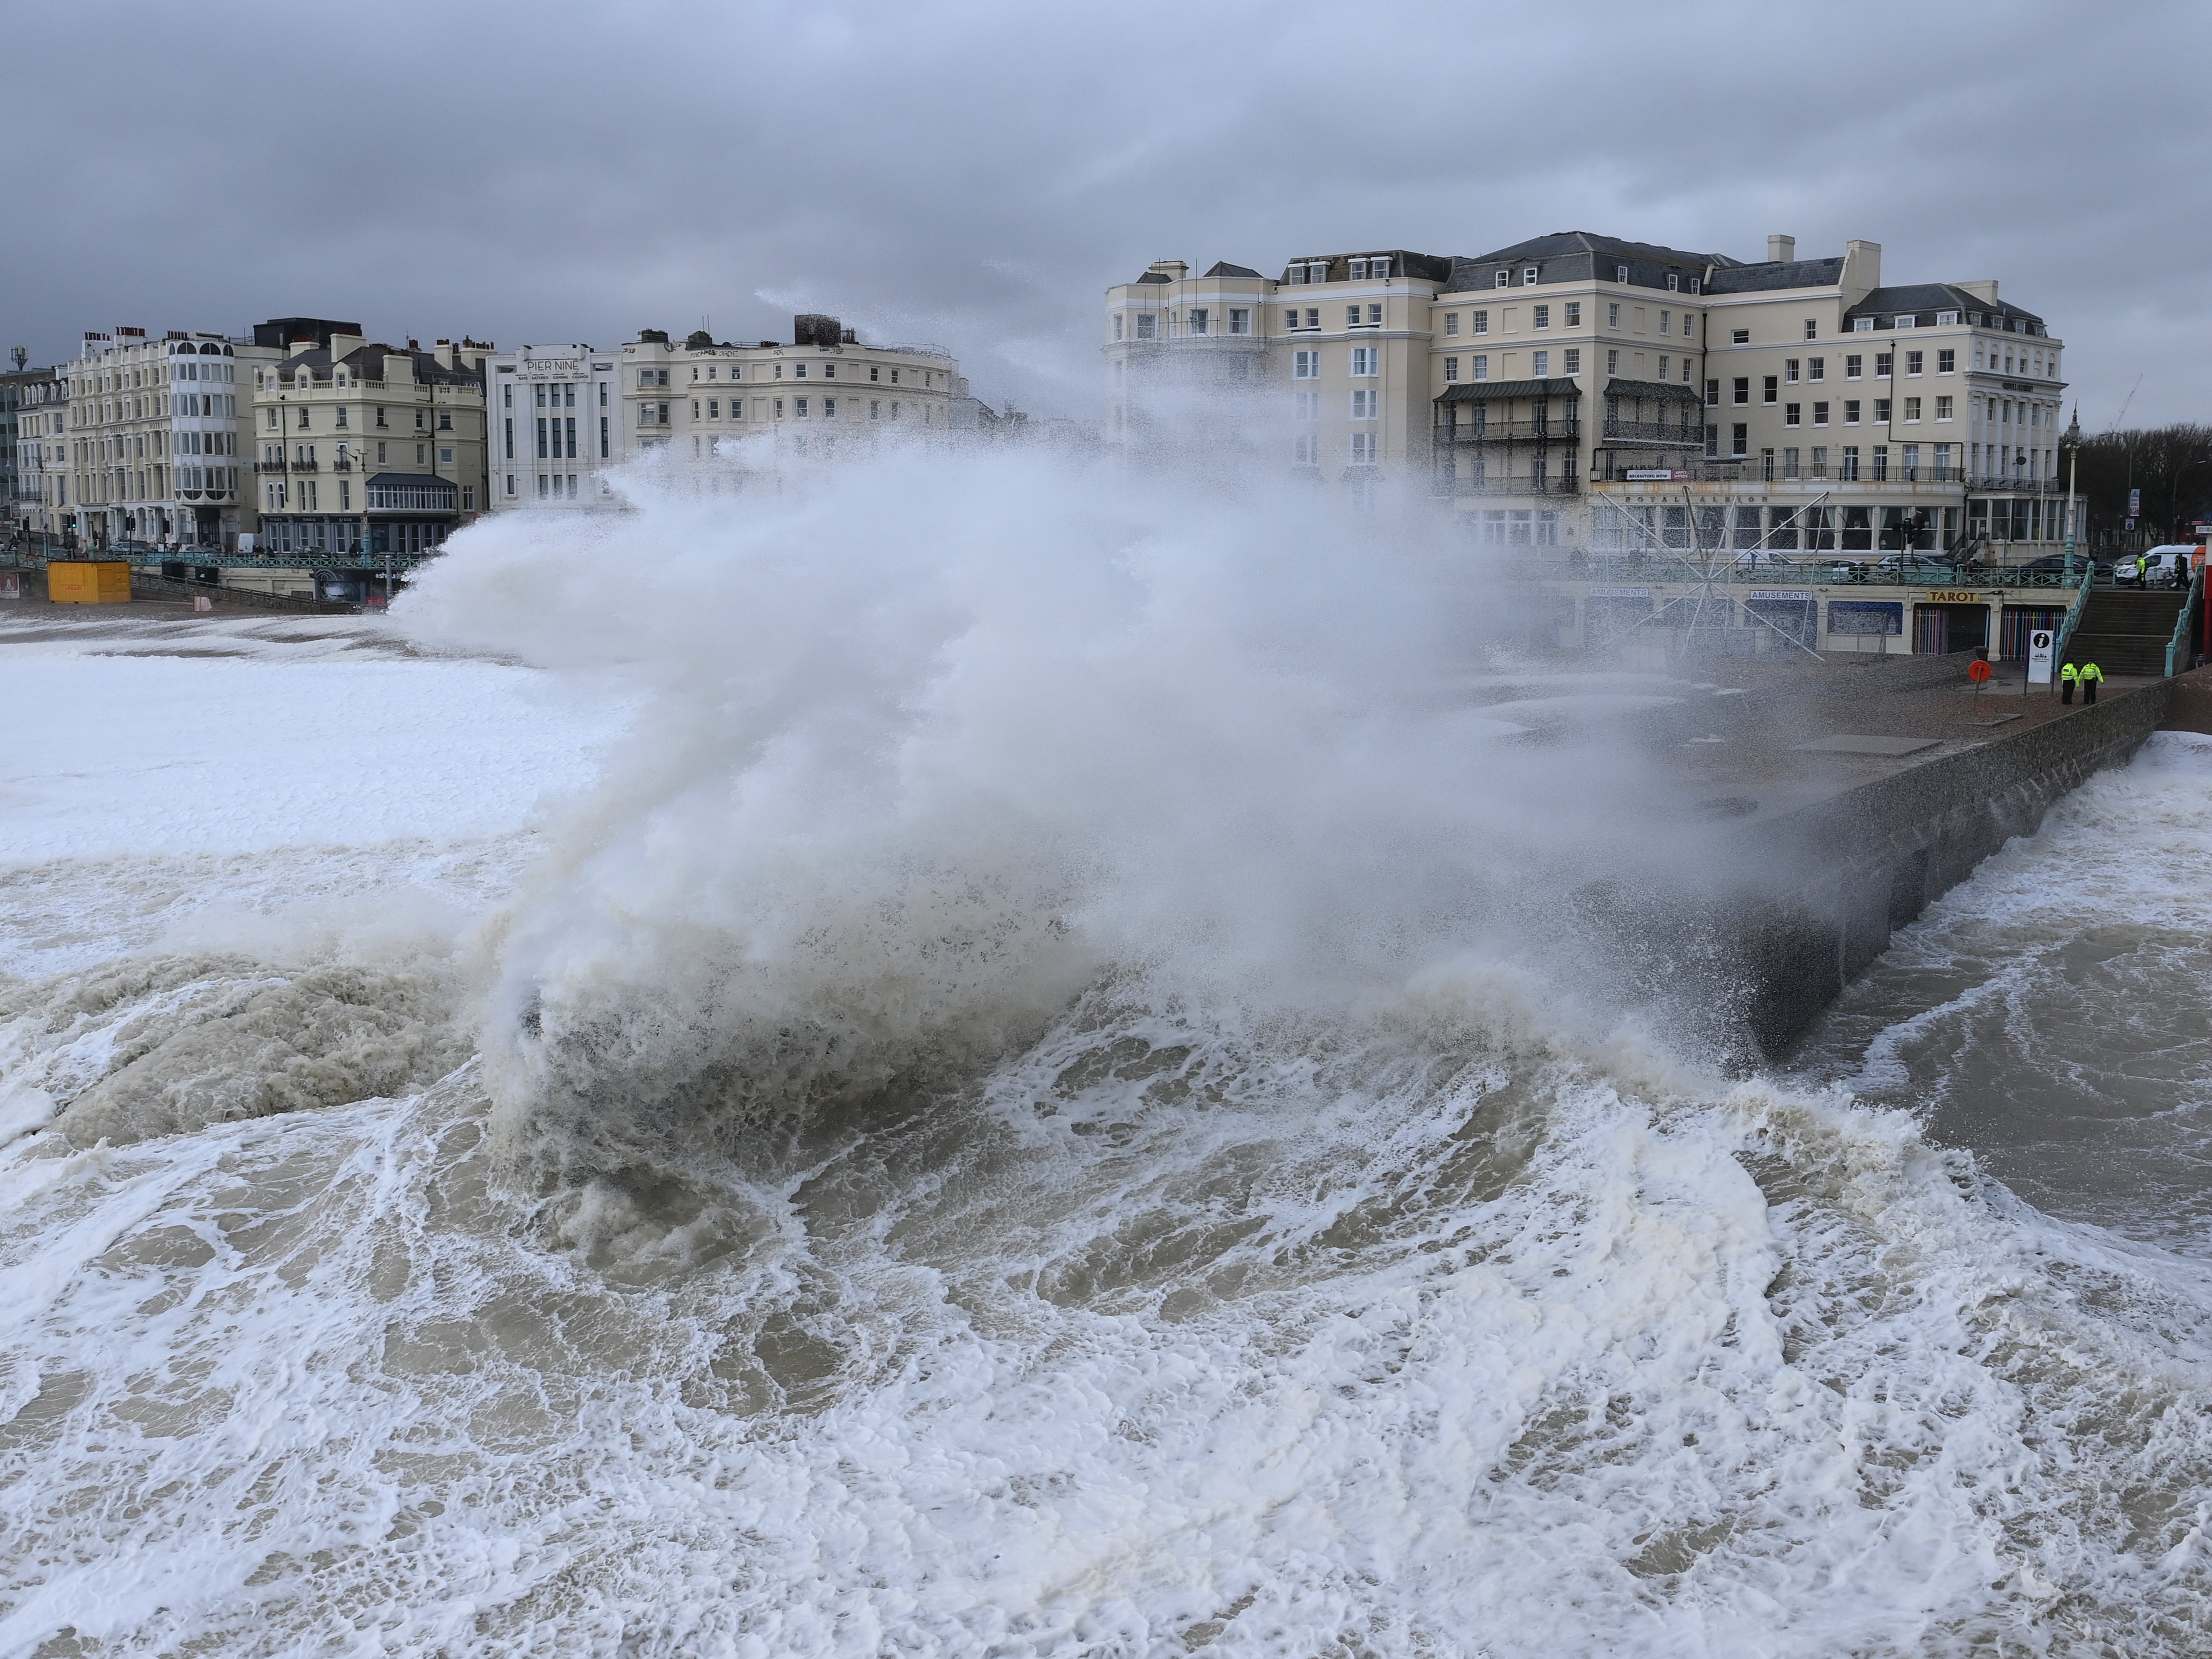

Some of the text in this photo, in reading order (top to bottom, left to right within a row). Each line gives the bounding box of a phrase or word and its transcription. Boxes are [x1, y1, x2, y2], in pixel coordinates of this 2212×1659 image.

[527, 360, 579, 371] PIER NINE
[1930, 592, 1976, 601] TAROT
